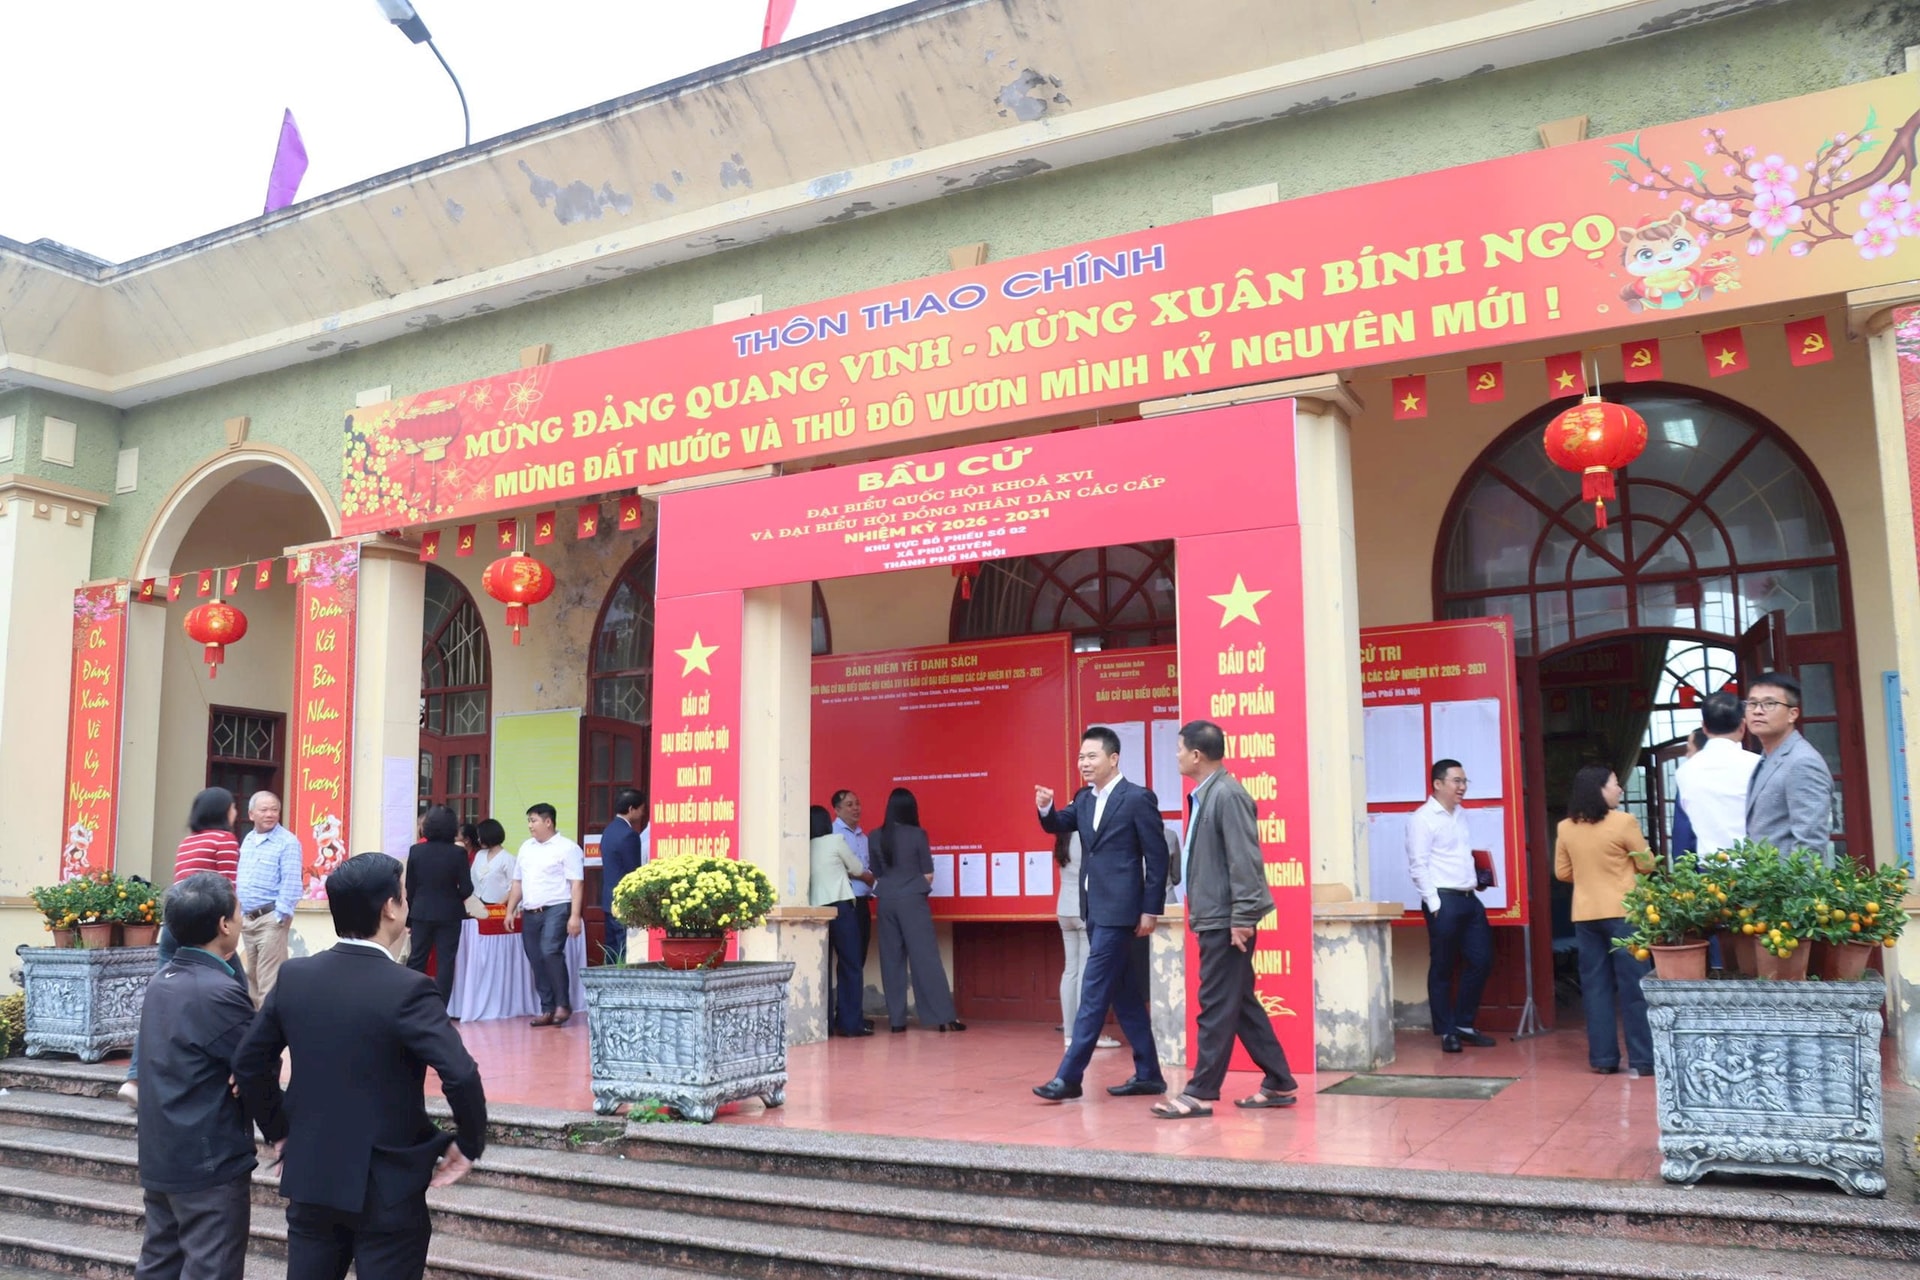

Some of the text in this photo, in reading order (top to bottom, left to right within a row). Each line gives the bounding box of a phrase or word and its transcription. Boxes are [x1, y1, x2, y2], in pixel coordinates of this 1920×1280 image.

[732, 244, 1166, 357] THÔN THAO CHÍNH
[464, 416, 565, 461] MỪNG
[571, 395, 676, 439] ĐẢNG
[685, 361, 831, 418] QUANG
[840, 336, 951, 384] VINH
[987, 300, 1138, 359] MỪNG
[1149, 267, 1307, 327] XUÂN
[1321, 240, 1466, 297] BÍNH
[1480, 214, 1616, 269] NGỌ
[494, 286, 1561, 499] MỪNG ĐẤT NƯỚC VÀ THỦ ĐÔ VƯƠN MÌNH KỶ NGUYÊN MỚI !
[858, 446, 1033, 492] BẦU CỬ
[751, 529, 774, 541] VÀ
[779, 525, 810, 538] ĐẠI
[816, 515, 857, 534] BIỂU
[863, 513, 896, 527] HỘI
[963, 496, 1026, 514] NHÂN
[1027, 488, 1071, 505] DÂN
[1076, 481, 1119, 498] CÁC
[1123, 474, 1166, 492] CẤP
[806, 469, 1094, 519] ĐẠI BIỂU QUỐC HỘI KHOÁ XVI
[844, 524, 906, 544] NHIỆM
[910, 520, 937, 536] KỲ
[941, 515, 988, 531] 2026
[1005, 507, 1050, 525] 2031
[864, 543, 891, 553] KHU
[894, 539, 919, 550] VỰC
[987, 526, 1006, 537] SỐ
[1009, 526, 1028, 535] 02
[310, 596, 343, 621] Đoàn
[89, 626, 107, 649] Ơn
[315, 628, 336, 652] Kết
[1218, 642, 1266, 675] BẦU CỬ
[1379, 645, 1402, 662] TRI
[82, 659, 111, 685] Đảng
[81, 689, 109, 711] Xuân
[306, 698, 340, 724] Nhau
[1210, 683, 1275, 718] GÓP PHẦN
[87, 719, 102, 740] Về
[301, 734, 342, 765] Hướng
[1222, 731, 1276, 763] ÂY DỰNG
[83, 749, 101, 777] Kỷ
[70, 782, 112, 808] Nguyên
[302, 768, 340, 800] Tương
[1251, 950, 1282, 980] ẠNH
